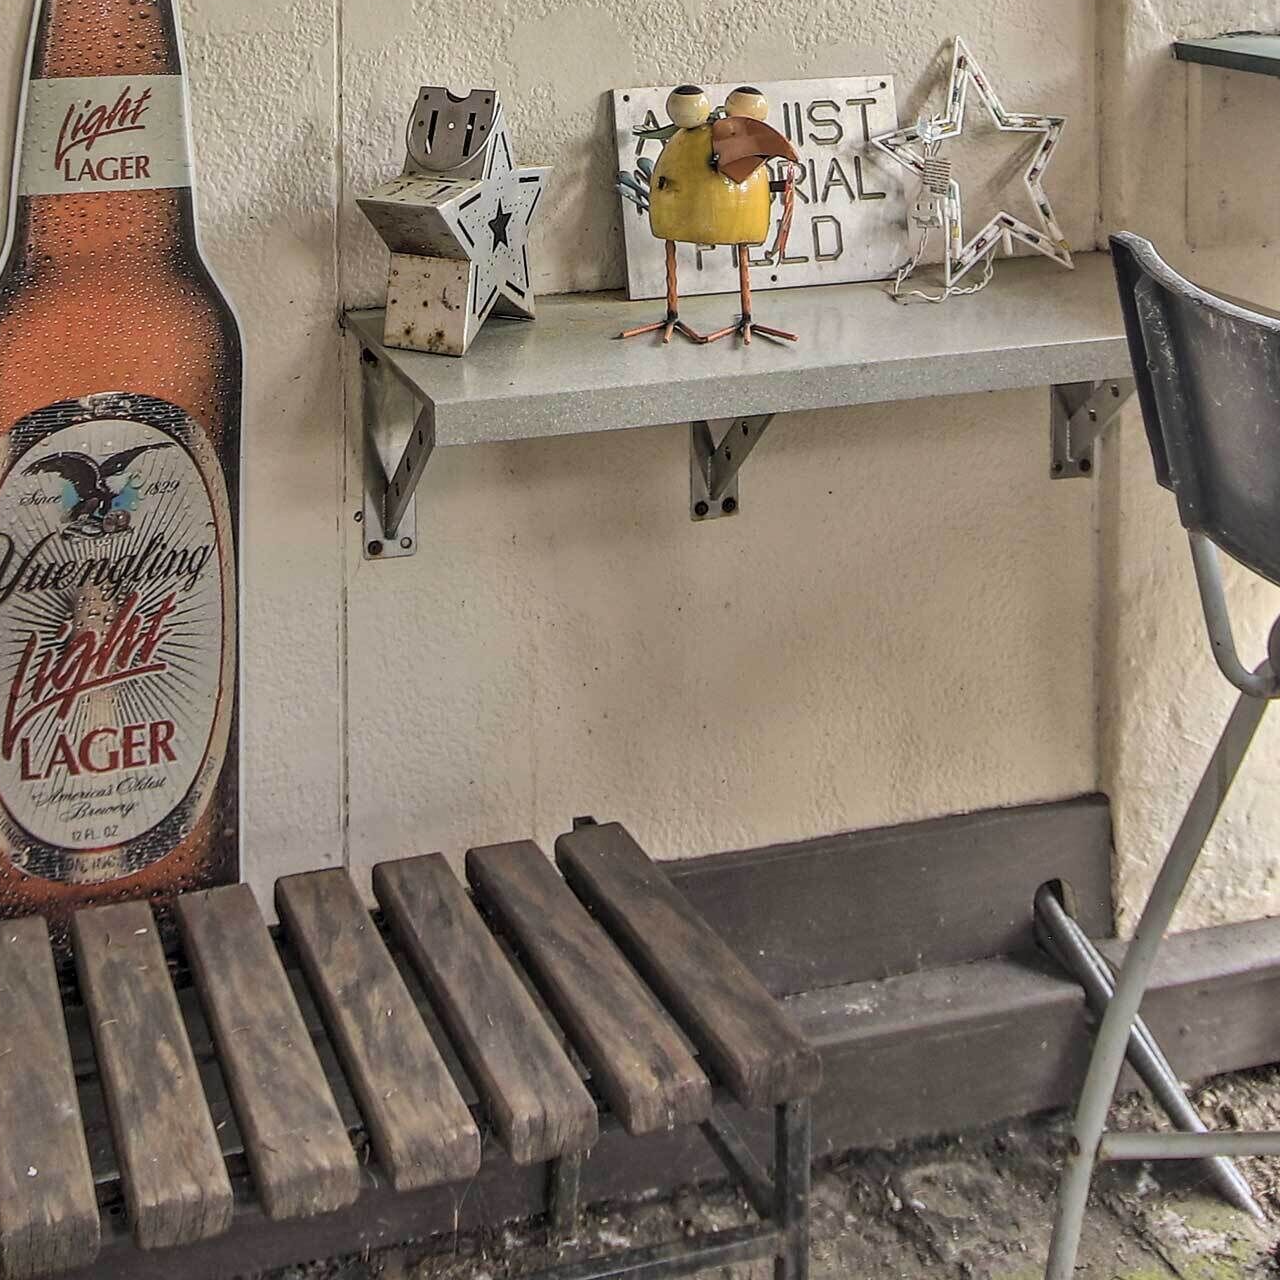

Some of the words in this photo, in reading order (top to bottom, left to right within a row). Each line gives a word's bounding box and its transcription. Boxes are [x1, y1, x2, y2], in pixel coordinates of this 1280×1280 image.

[55, 86, 152, 170] Light
[64, 155, 151, 182] LAGER
[19, 489, 63, 507] Since
[144, 480, 181, 497] 1829
[1, 591, 177, 760] Light
[20, 720, 177, 781] LAGER
[32, 783, 113, 807] America's
[116, 776, 166, 796] Oldest
[60, 800, 138, 823] Brewery
[103, 825, 119, 838] OZ
